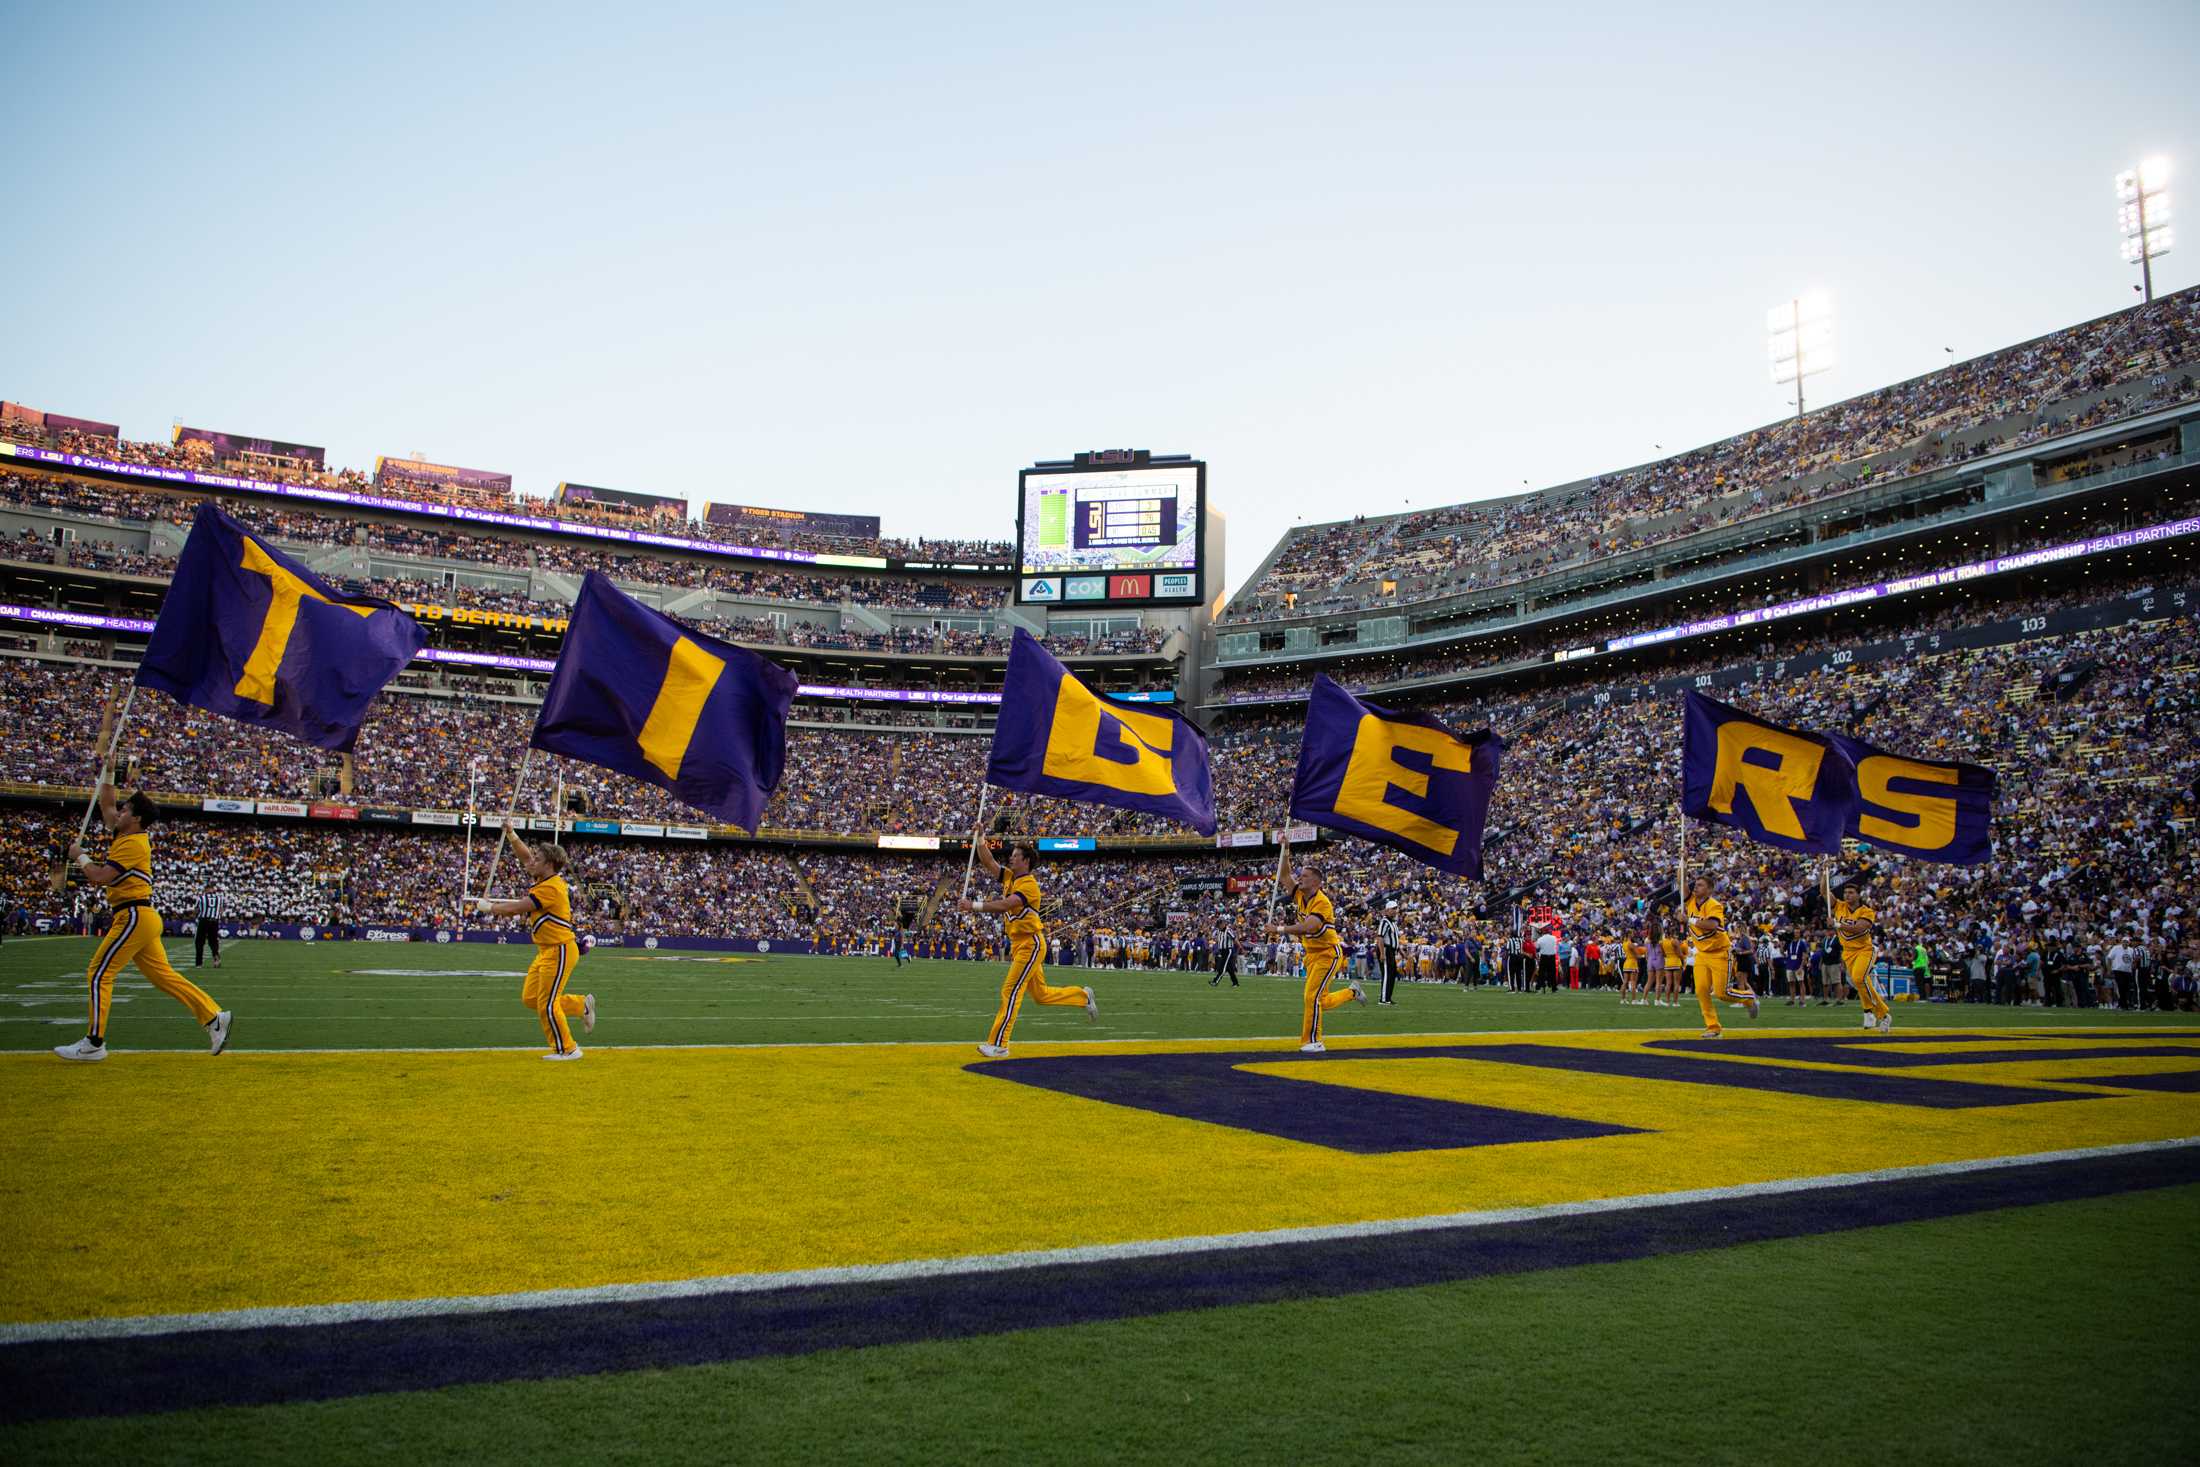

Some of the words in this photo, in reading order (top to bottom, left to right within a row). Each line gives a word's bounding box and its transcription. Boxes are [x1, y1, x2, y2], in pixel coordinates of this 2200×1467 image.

[41, 452, 63, 462] LSU
[1089, 448, 1134, 464] LSU
[84, 459, 99, 469] Our
[100, 461, 118, 473] Lady
[119, 465, 129, 473] of
[130, 466, 142, 475] the
[143, 468, 161, 477] Lake
[162, 470, 186, 481] Health
[194, 474, 239, 487] TOGETHER
[239, 480, 254, 489] WE
[255, 482, 278, 492] ROAR
[286, 488, 350, 502] CHAMPIONSHIP
[351, 494, 381, 506] HEALTH
[382, 497, 422, 512] PARTNERS
[428, 505, 448, 515] LSU
[479, 511, 494, 523] Lady
[559, 523, 596, 535] TOGETHER
[597, 528, 610, 536] WE
[636, 533, 691, 547] CHAMPIONSHIP
[691, 541, 718, 551] HEALTH
[718, 544, 753, 556] PARTNERS
[1997, 544, 2086, 572] CHAMPIONSHIP
[2087, 533, 2132, 553] HEALTH
[2135, 520, 2200, 543] PARTNERS
[1886, 575, 1937, 593] TOGETHER
[1938, 571, 1955, 583] WE
[1956, 564, 1986, 581] ROAR
[1068, 581, 1105, 595] COX
[1773, 606, 1788, 618] Our
[1789, 602, 1808, 614] Lady
[1808, 601, 1818, 611] of
[1818, 598, 1831, 608] the
[1831, 594, 1850, 606] Lake
[1850, 589, 1877, 602] Health
[31, 610, 105, 626] CHAMPIONSHIP
[106, 619, 140, 630] HEALTH
[234, 535, 376, 705] T
[452, 608, 532, 629] DEATH
[1689, 619, 1728, 634] PARTNERS
[1735, 613, 1756, 625] LSU
[2021, 616, 2047, 632] 103
[436, 650, 499, 664] CHAMPIONSHIP
[499, 658, 529, 668] HEALTH
[1832, 650, 1853, 664] 102
[1695, 675, 1713, 687] 101
[836, 689, 863, 698] HEALTH
[864, 690, 899, 700] PARTNERS
[908, 692, 925, 700] LSU
[941, 693, 953, 701] Our
[954, 693, 969, 702] Lady
[1593, 692, 1610, 705] 100
[1042, 673, 1176, 794] G
[1334, 714, 1472, 856] E
[1707, 721, 1826, 841] R
[1857, 755, 1959, 850] S
